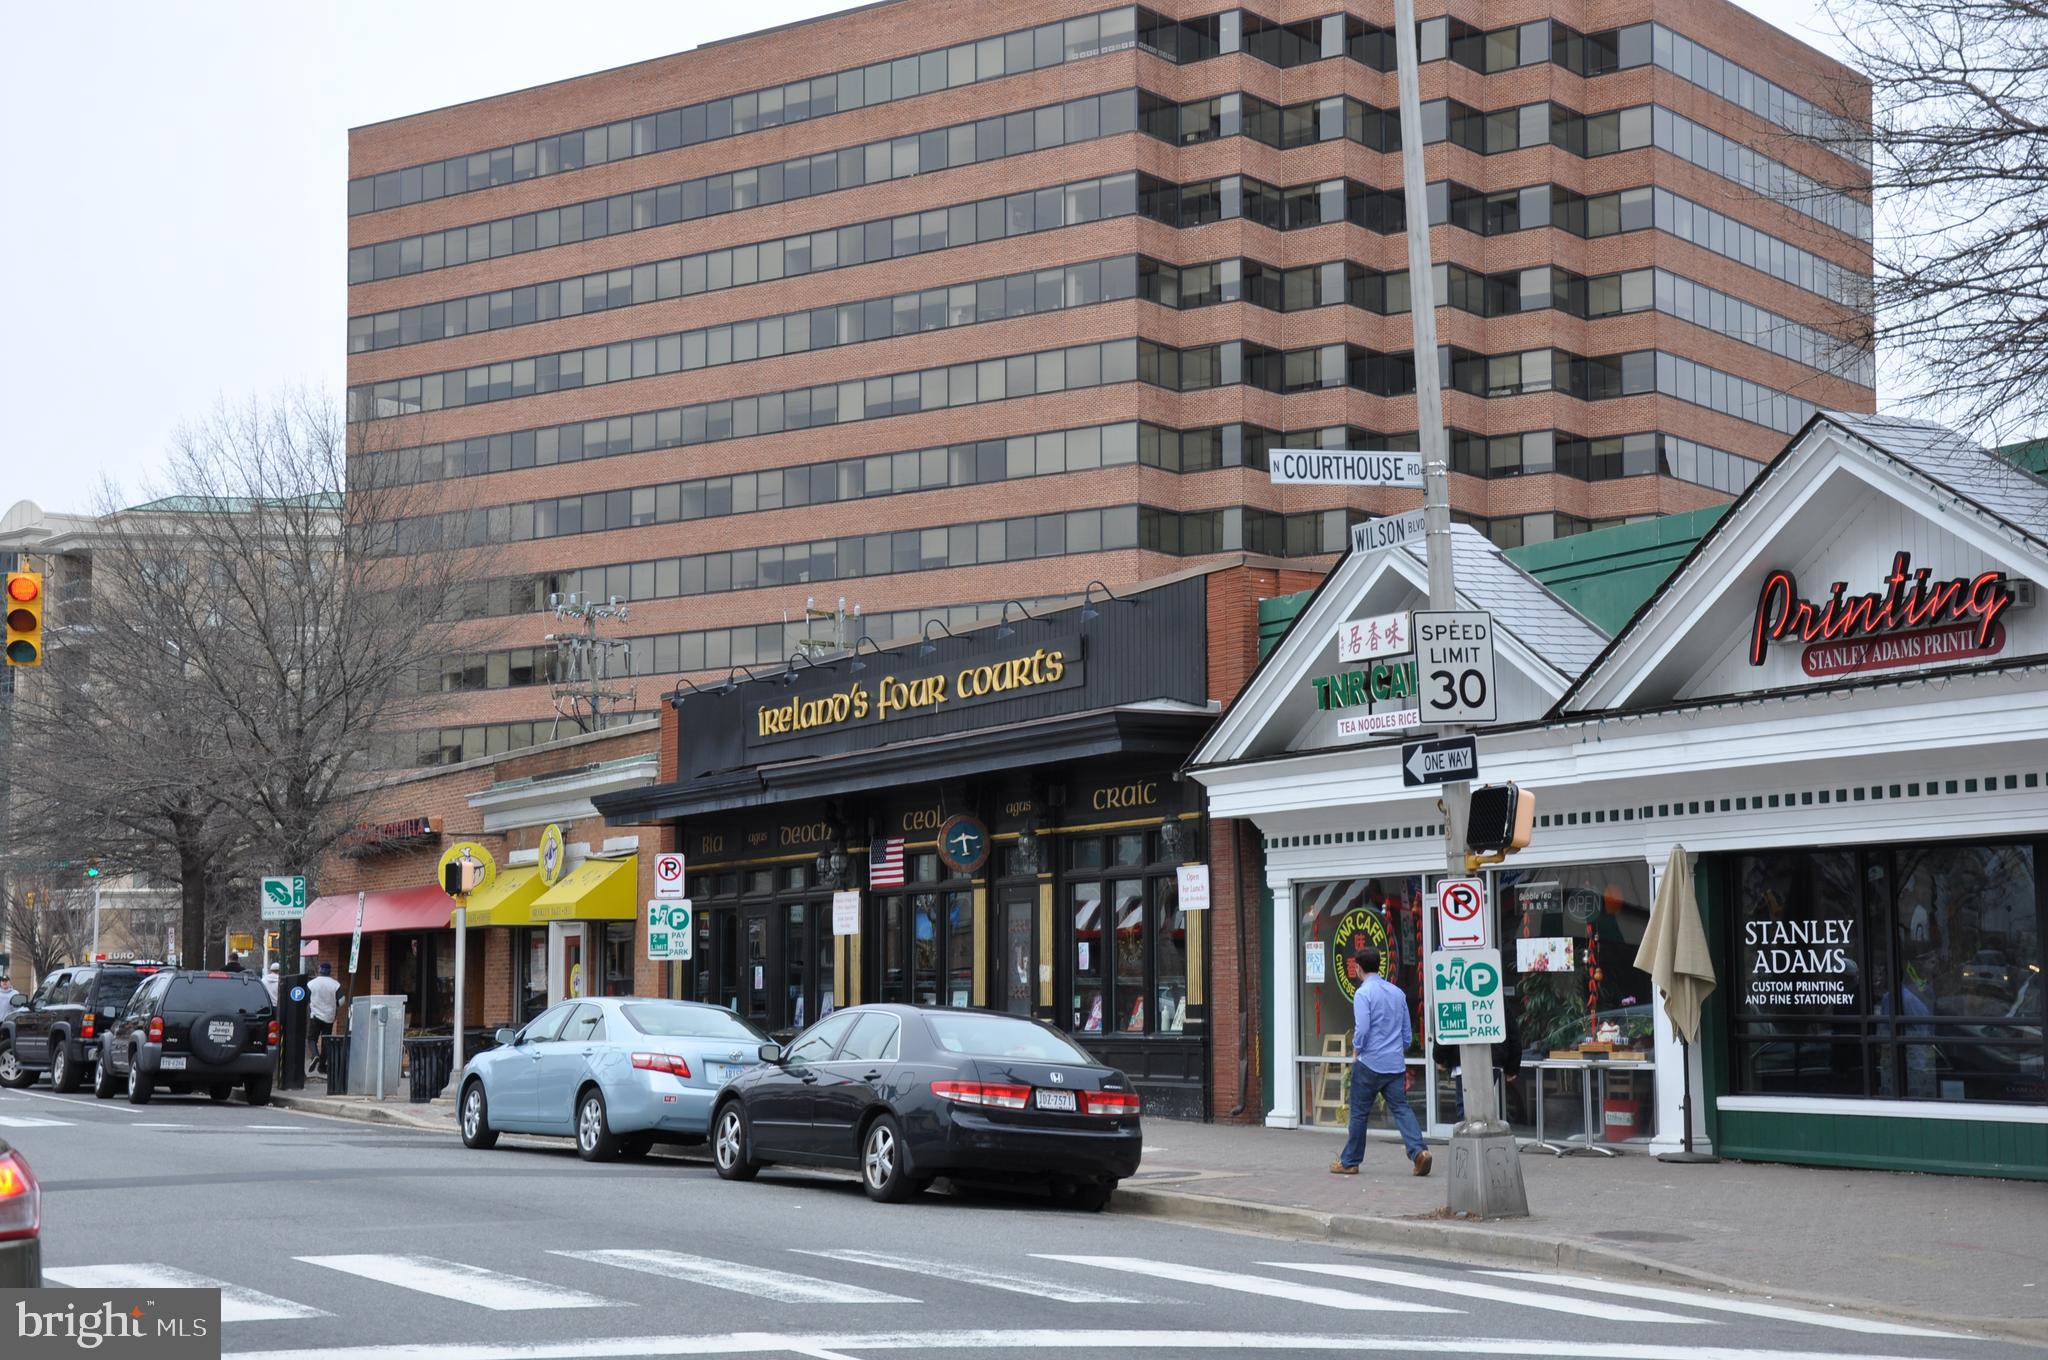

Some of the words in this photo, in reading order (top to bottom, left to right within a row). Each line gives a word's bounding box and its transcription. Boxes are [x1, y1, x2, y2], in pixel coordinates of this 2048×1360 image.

[1272, 460, 1280, 473] N
[1283, 454, 1405, 481] COURTHOUSE
[1407, 463, 1420, 476] RD
[1354, 517, 1405, 553] WILSON
[1407, 517, 1425, 534] BLVD
[1750, 551, 2015, 666] Printing
[1422, 624, 1487, 641] SPEED
[1430, 647, 1480, 664] LIMIT
[1808, 645, 1869, 671] STANLEY
[1872, 637, 1921, 662] ADAMS
[1923, 630, 1996, 656] PRINTI
[1312, 670, 1369, 712] TNR
[1430, 668, 1487, 711] 30
[1339, 719, 1357, 734] TEA
[1357, 714, 1396, 731] NOODLES
[1398, 711, 1418, 726] RICE
[1424, 753, 1446, 771] ONE
[1448, 750, 1469, 769] WAY
[294, 879, 304, 890] 2
[1567, 894, 1601, 913] OPEN
[672, 911, 685, 927] P
[671, 931, 686, 939] PAY
[1336, 915, 1355, 947] TNR
[1356, 911, 1384, 947] CAFE
[1744, 919, 1854, 945] STANLEY
[652, 934, 658, 943] 2
[674, 940, 684, 948] TO
[108, 951, 134, 960] EURO
[669, 948, 688, 956] PARK
[1752, 948, 1847, 974] ADAMS
[1471, 968, 1492, 991] P
[1751, 981, 1793, 992] CUSTOM
[1796, 980, 1845, 992] PRINTING
[1471, 999, 1495, 1011] PAY
[1745, 994, 1767, 1005] AND
[1769, 994, 1792, 1005] FINE
[1793, 993, 1855, 1005] STATIONERY
[1442, 1004, 1449, 1017] 2
[1452, 1003, 1463, 1012] HR
[1440, 1018, 1466, 1030] LIMIT
[1476, 1013, 1493, 1025] TO
[1470, 1026, 1501, 1037] PARK
